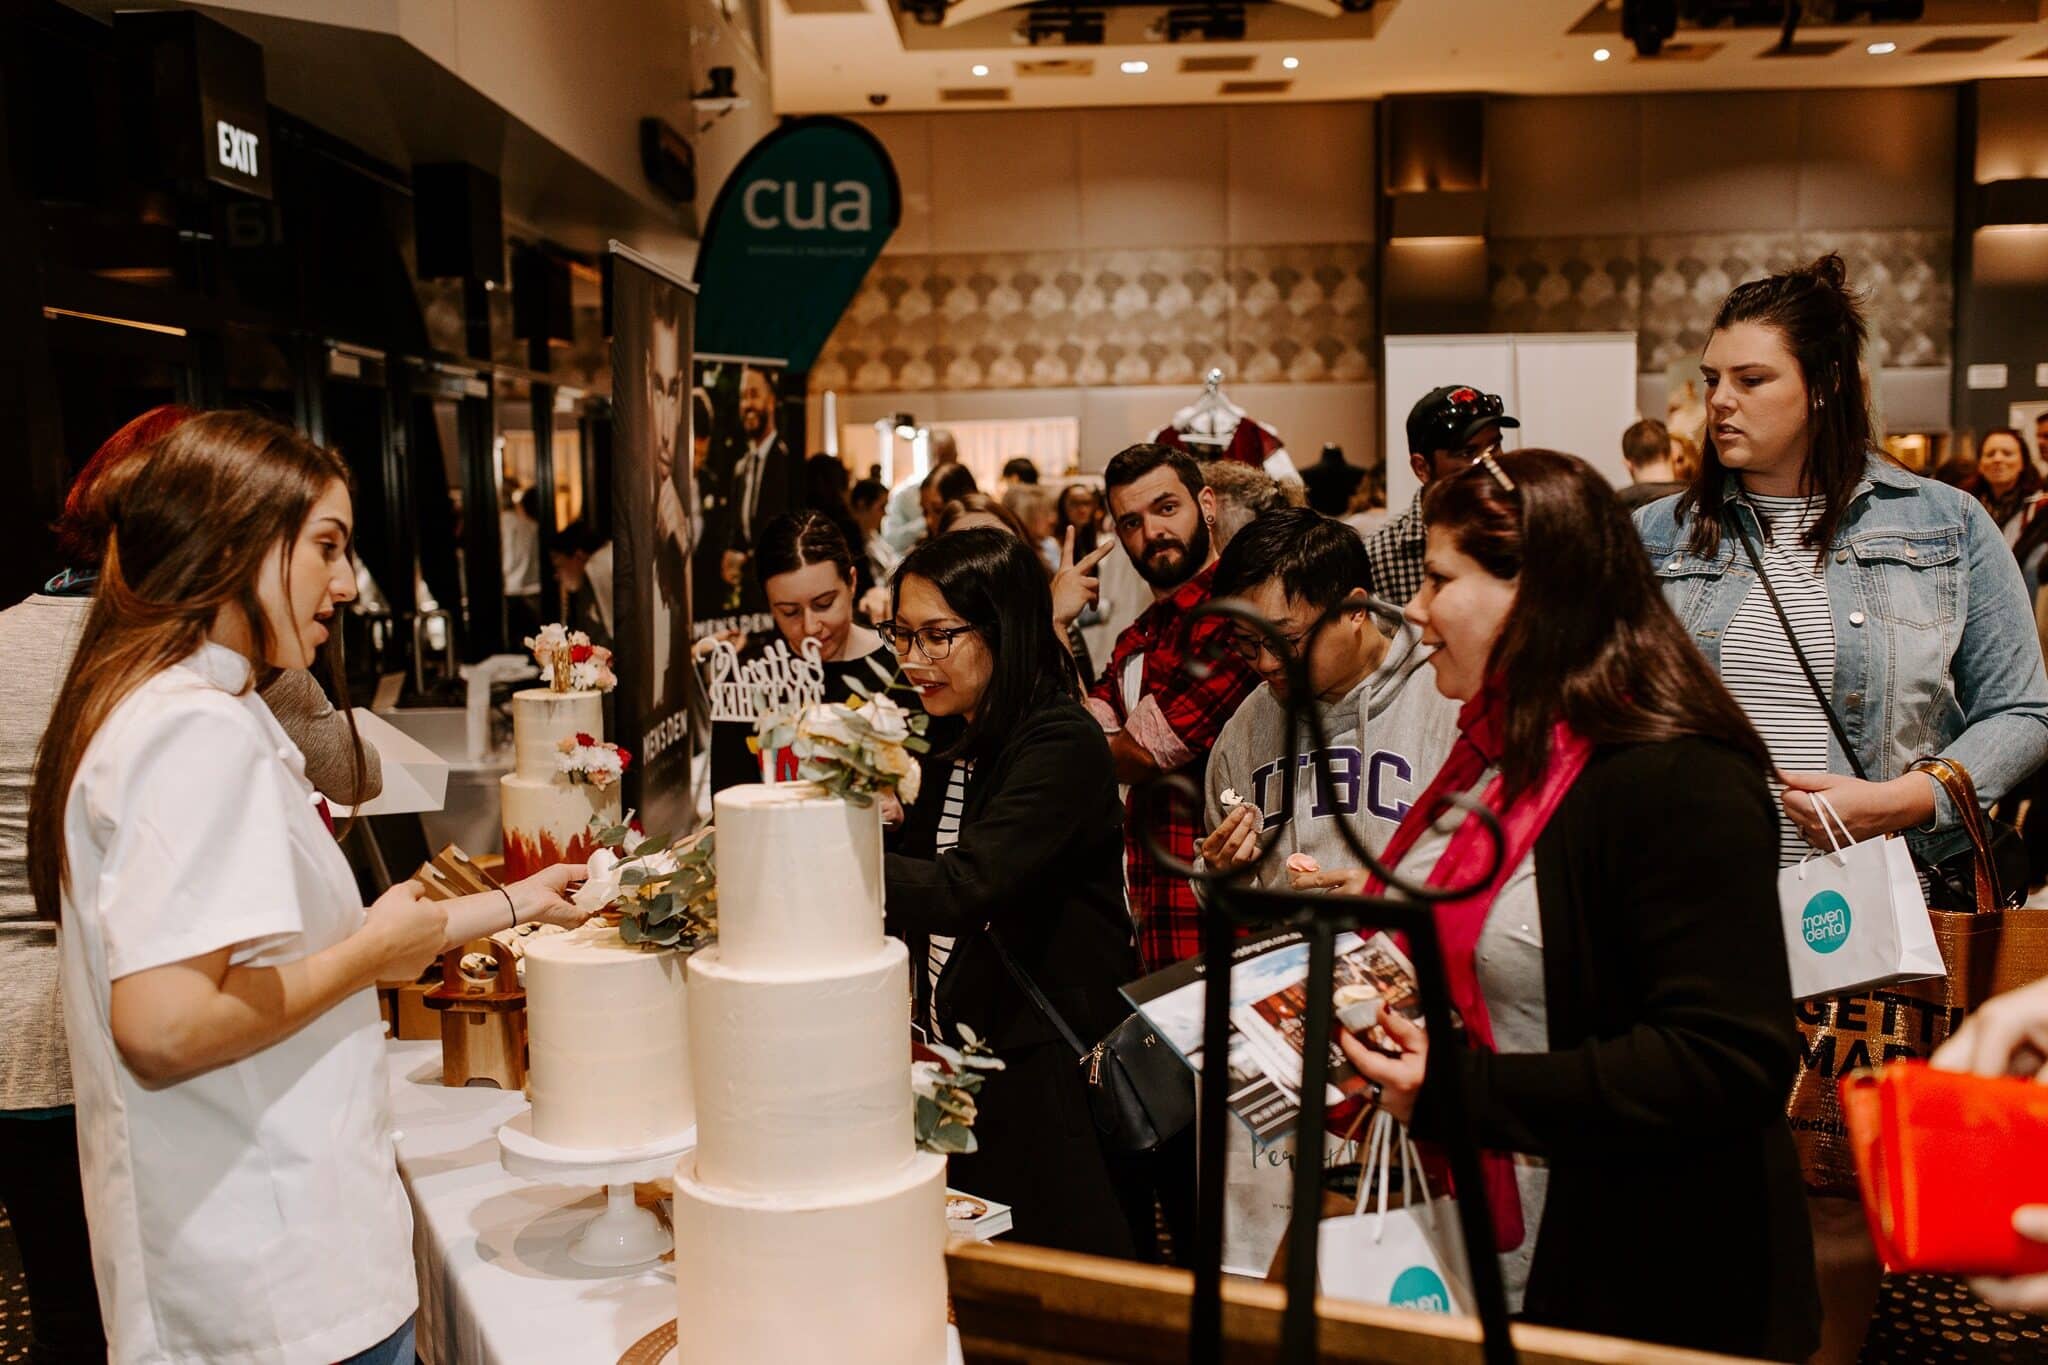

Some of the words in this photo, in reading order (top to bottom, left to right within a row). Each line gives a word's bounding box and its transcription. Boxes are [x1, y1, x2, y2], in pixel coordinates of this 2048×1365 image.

[217, 120, 258, 177] EXIT
[743, 179, 871, 231] cua
[643, 720, 666, 767] MEN'S
[666, 708, 688, 746] DEN
[1251, 745, 1414, 833] UBC
[1802, 908, 1844, 931] maven
[1805, 920, 1846, 943] dental
